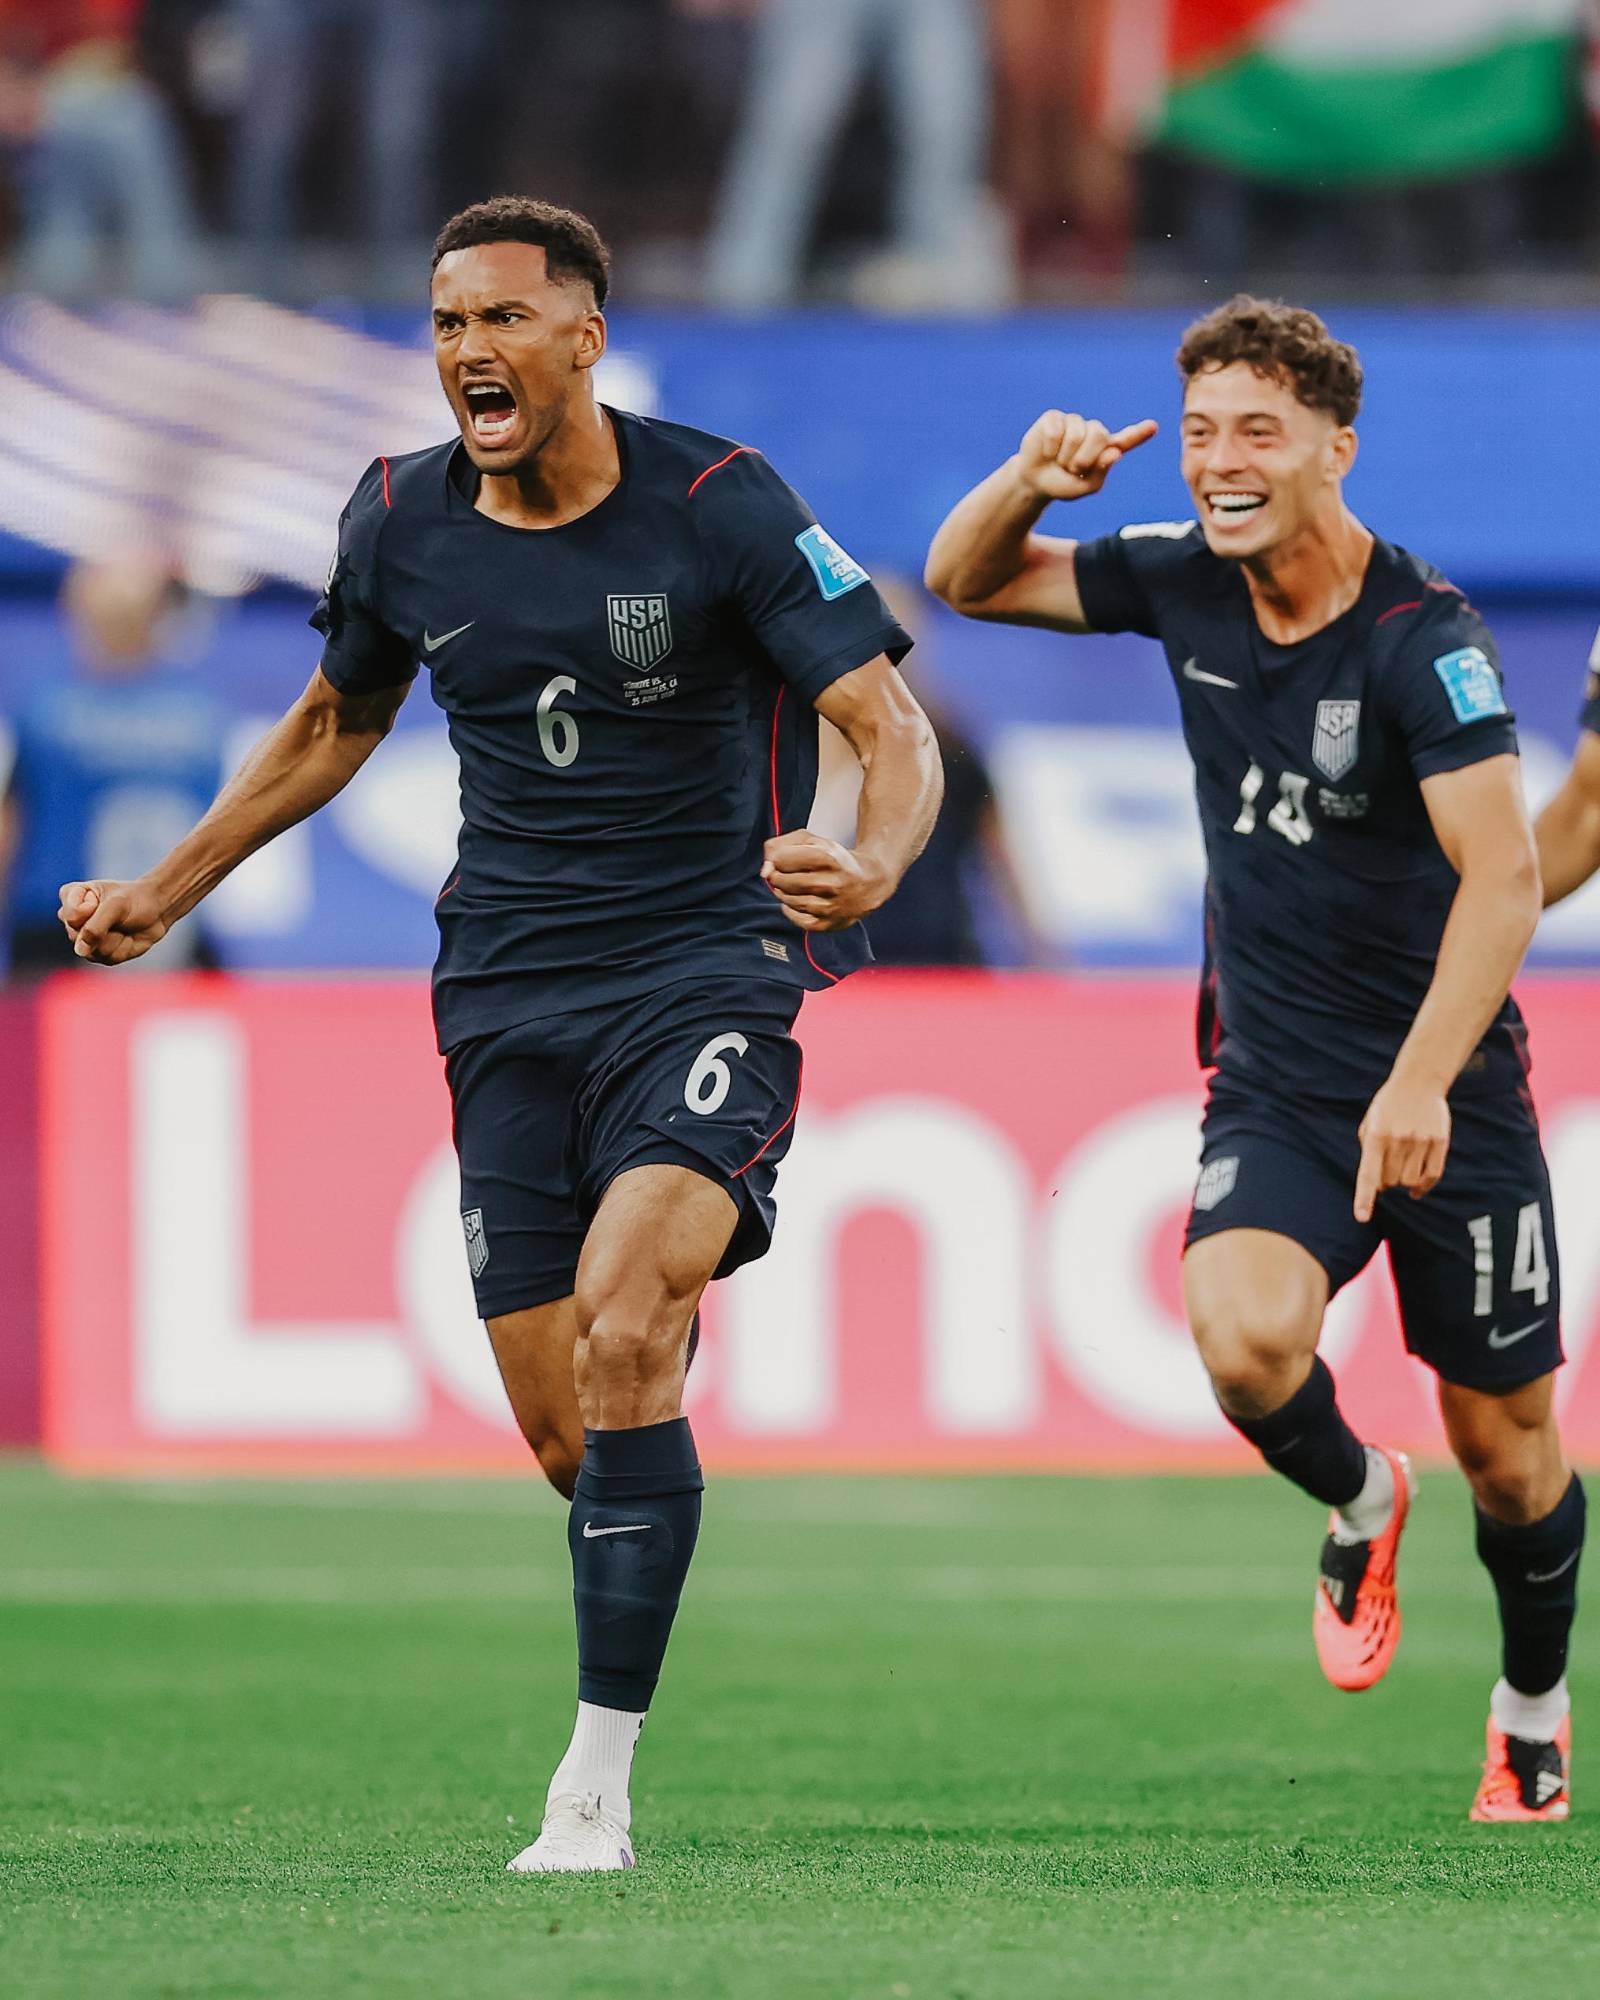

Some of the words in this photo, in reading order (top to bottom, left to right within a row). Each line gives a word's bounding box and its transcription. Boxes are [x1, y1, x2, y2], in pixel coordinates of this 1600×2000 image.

[612, 599, 664, 629] USA
[536, 675, 579, 768] 6
[1232, 761, 1314, 846] 14
[684, 1031, 749, 1115] 6
[462, 1213, 480, 1241] SA
[1467, 1201, 1551, 1317] 14
